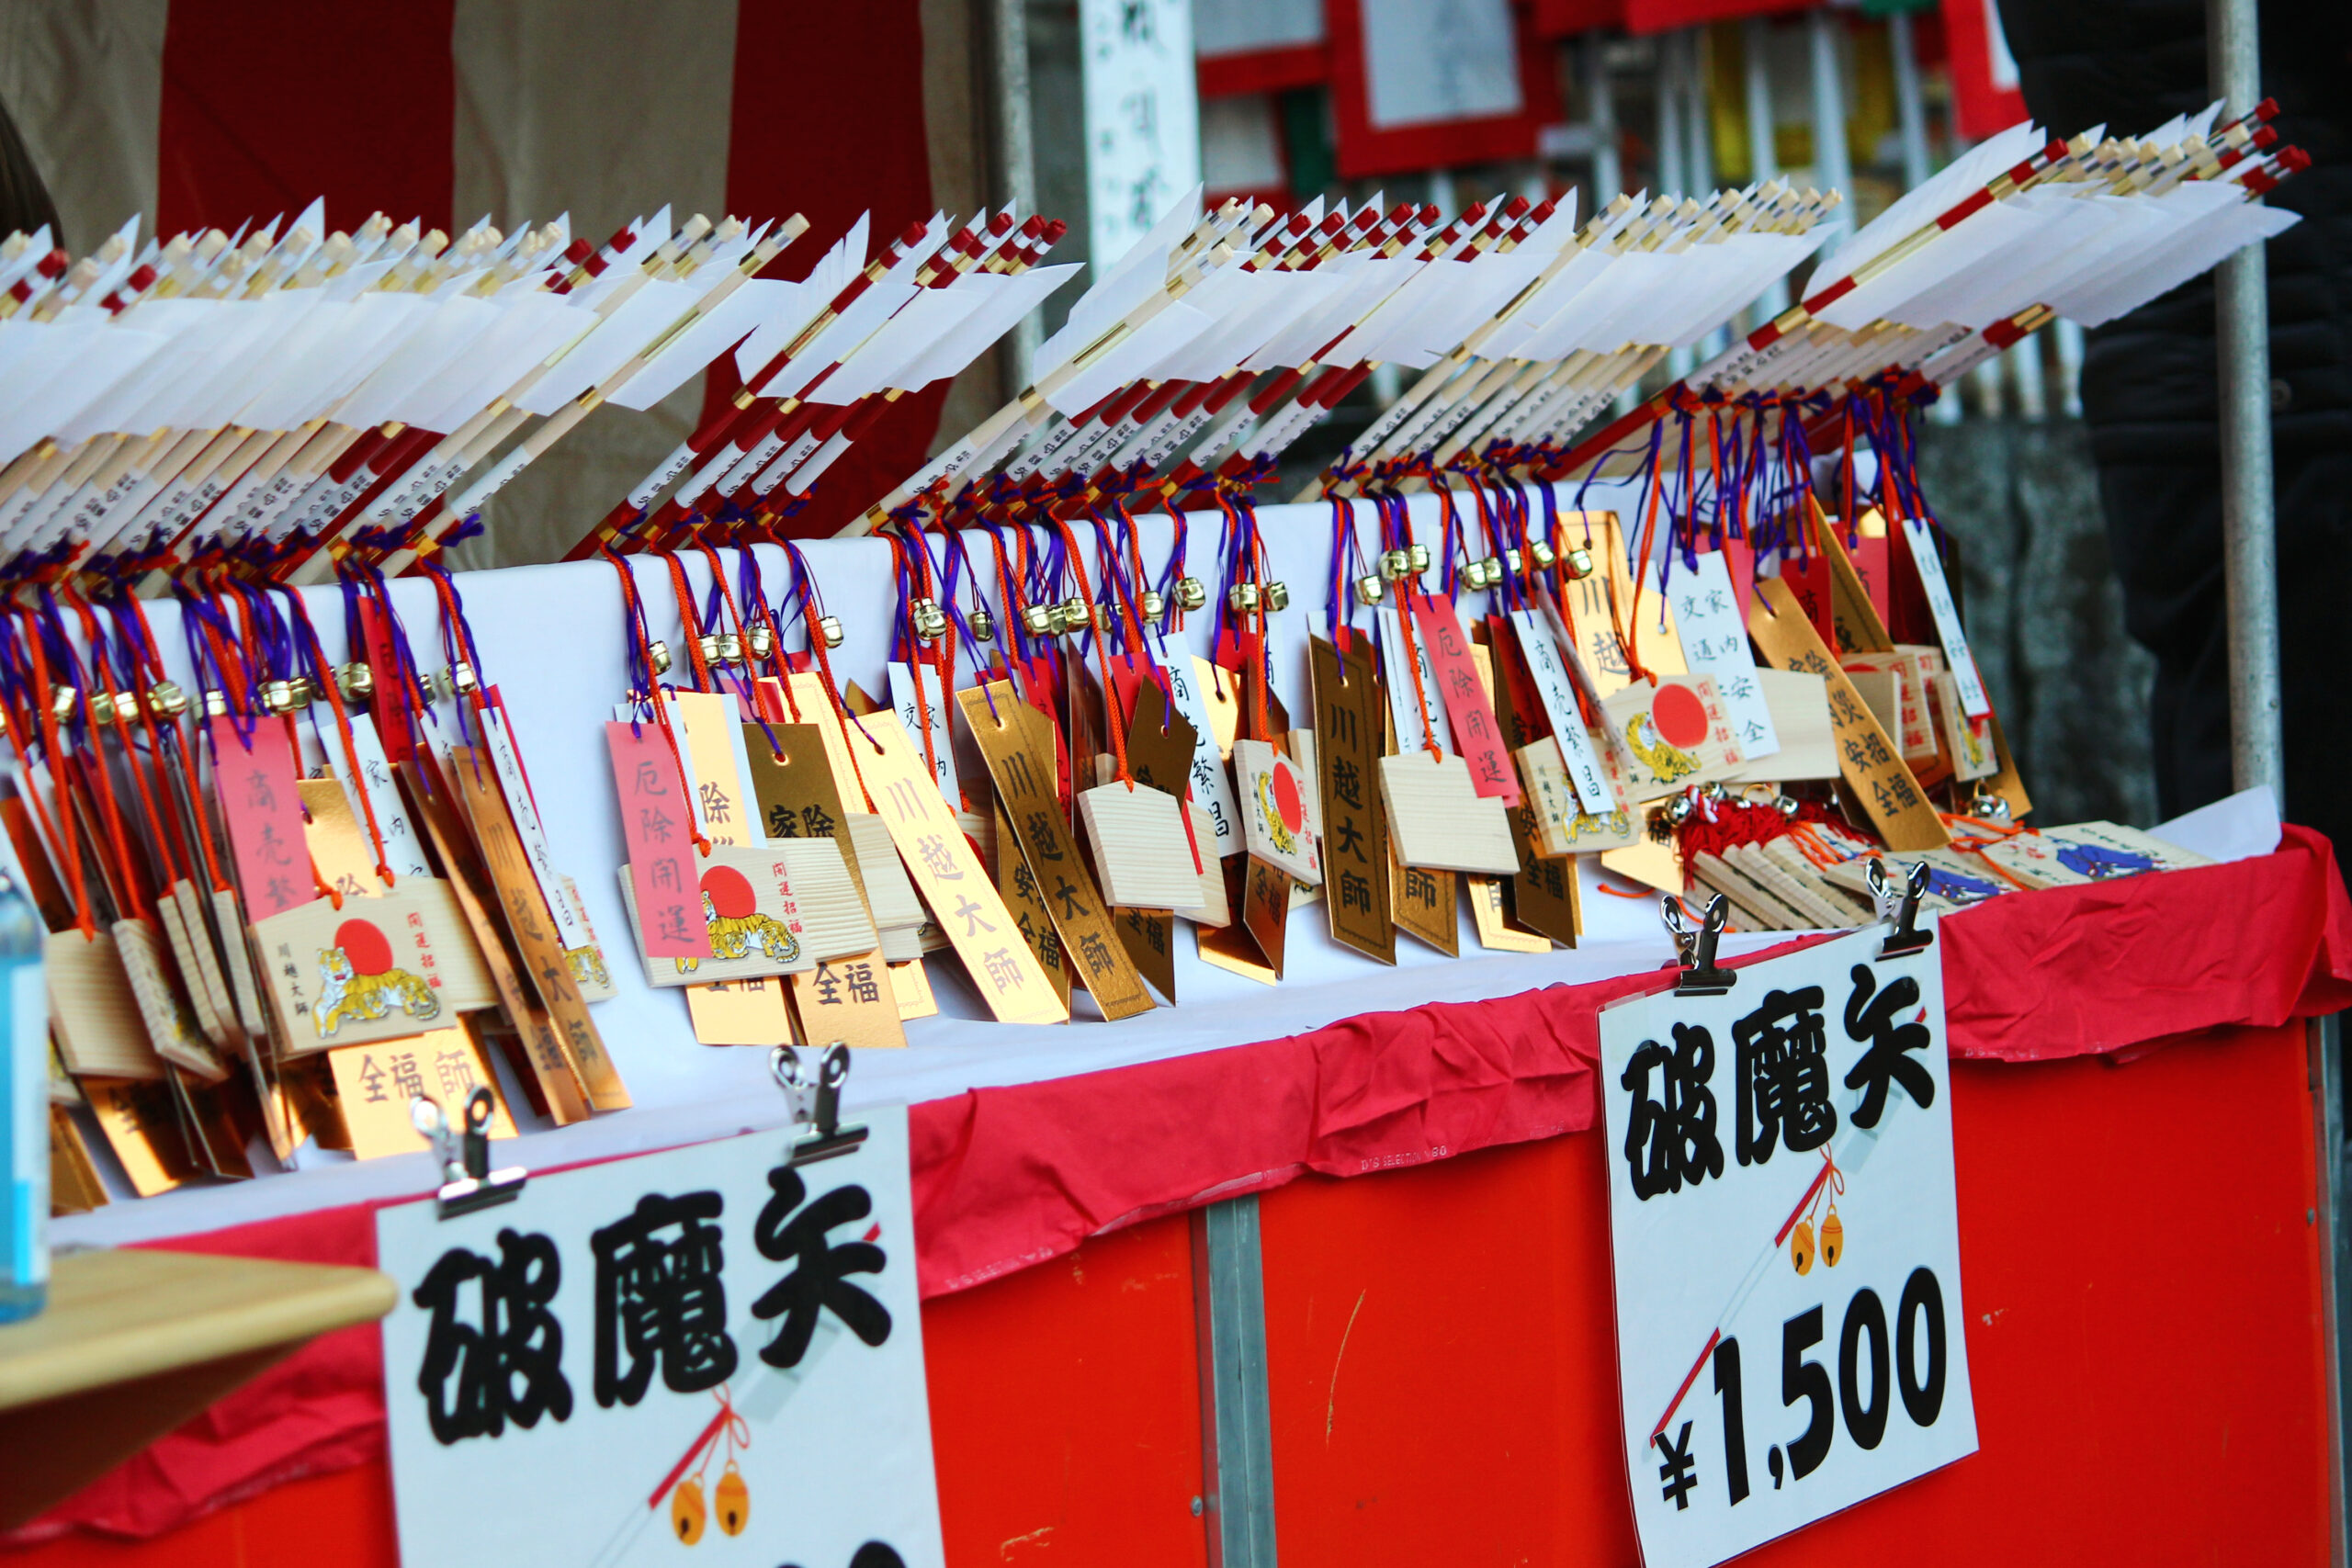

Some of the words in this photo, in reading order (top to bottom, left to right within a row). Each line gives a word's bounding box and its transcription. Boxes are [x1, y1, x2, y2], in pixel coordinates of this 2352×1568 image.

[1439, 626, 1508, 784] 厄除開運
[1579, 576, 1631, 687] 川越
[1704, 589, 1765, 744] 家内安全
[1698, 681, 1739, 766] 開運招福
[634, 761, 696, 943] 厄除開運
[699, 782, 734, 846] 除
[887, 777, 1024, 996] 川越大師
[1001, 750, 1115, 977] 川越大師
[1330, 704, 1372, 917] 川越大師
[772, 862, 802, 934] 開運招福
[1621, 964, 1935, 1201] 破魔矢
[413, 1166, 892, 1445] 破魔矢
